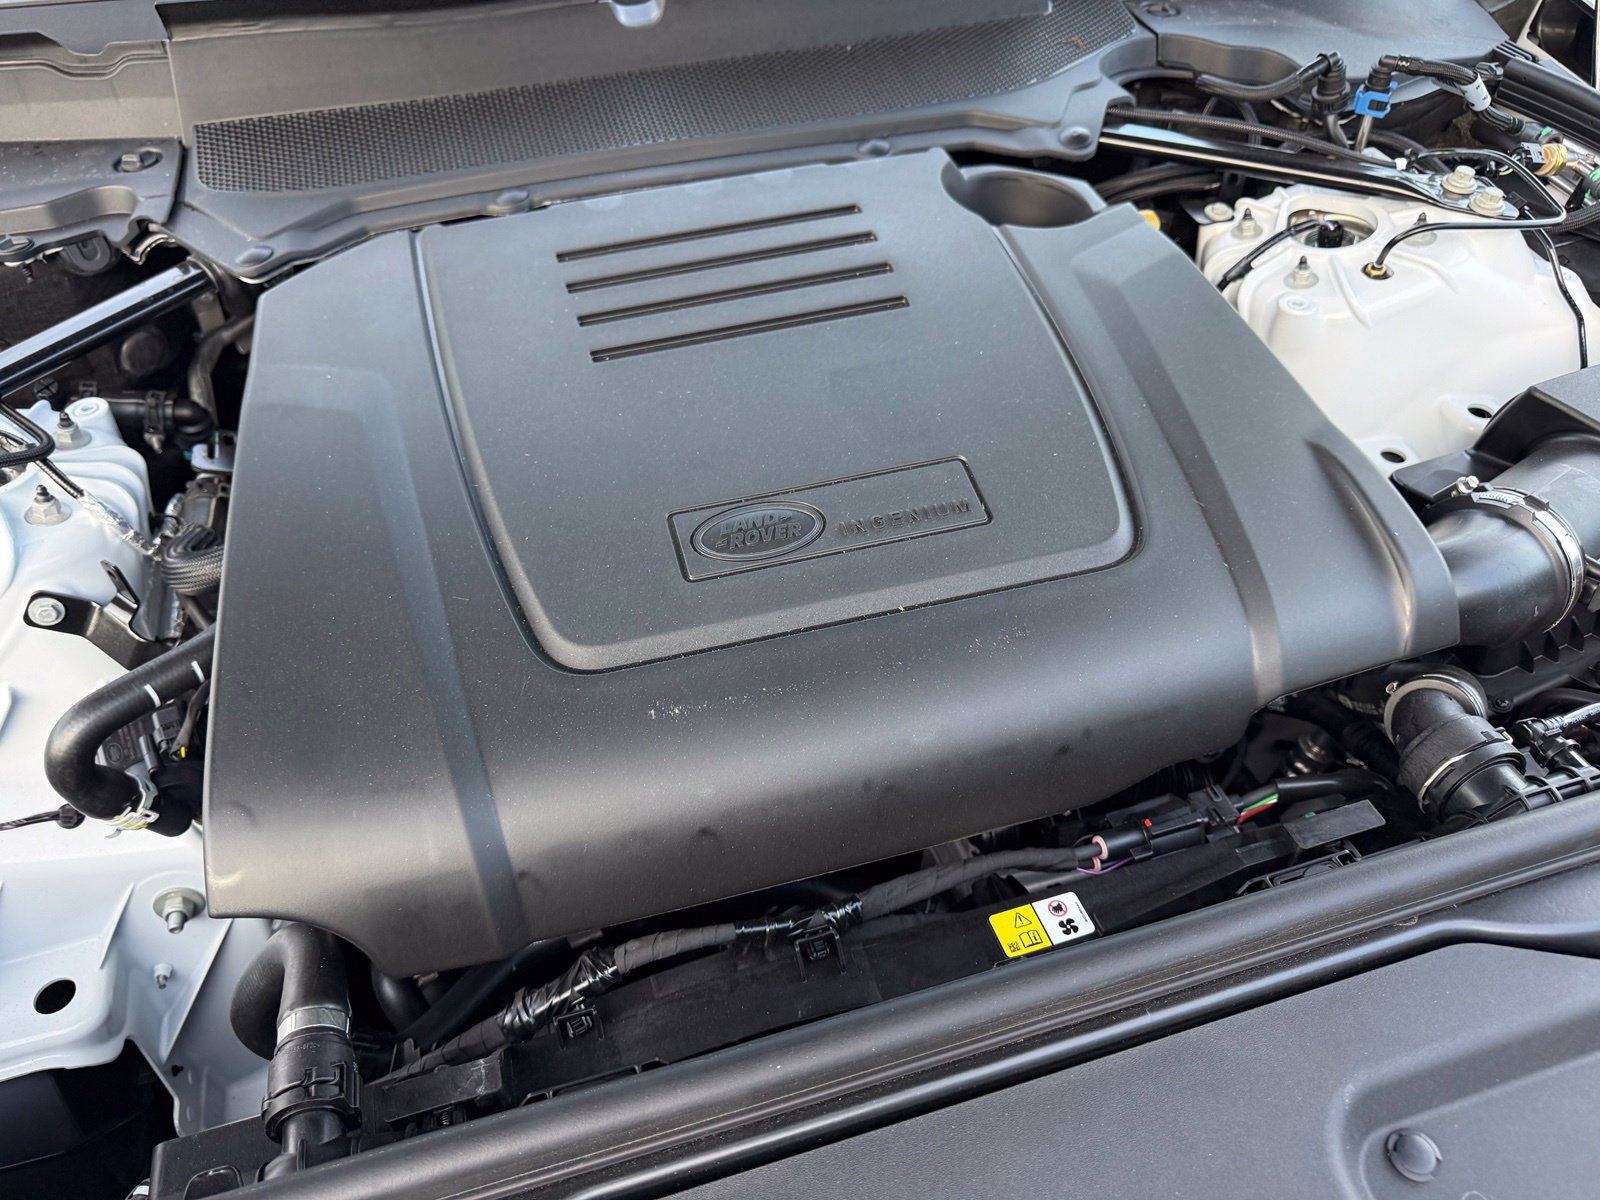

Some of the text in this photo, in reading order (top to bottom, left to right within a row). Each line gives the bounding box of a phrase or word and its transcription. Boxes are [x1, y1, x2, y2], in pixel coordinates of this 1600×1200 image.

[719, 511, 779, 537] LAND
[839, 498, 972, 536] INGENIUM
[730, 522, 802, 549] ROVER
